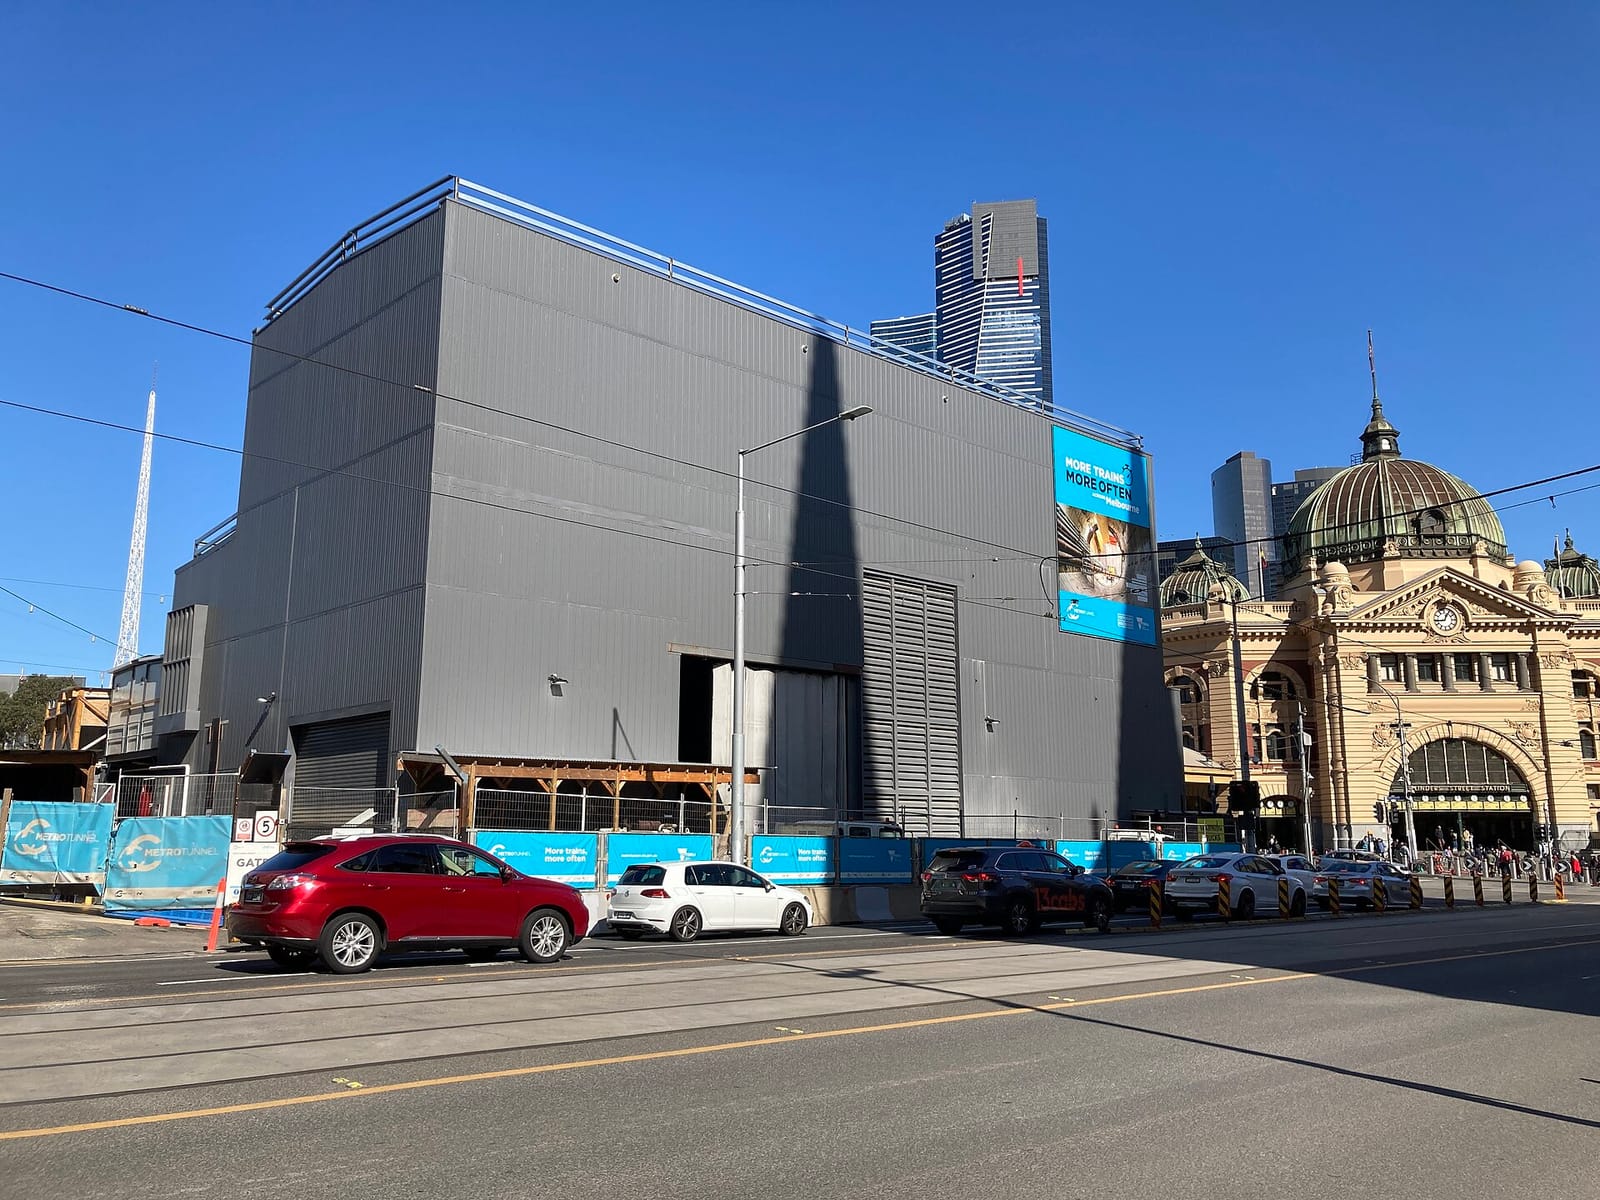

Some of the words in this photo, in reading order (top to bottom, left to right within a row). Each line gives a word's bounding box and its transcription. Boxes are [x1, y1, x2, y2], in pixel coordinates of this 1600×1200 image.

[1065, 457, 1092, 474] MORE
[1093, 465, 1125, 485] TRAINS
[1066, 470, 1097, 491] MORE
[1098, 481, 1132, 500] OFTEN
[1105, 496, 1140, 514] Melbourne
[262, 820, 270, 833] 5
[544, 847, 564, 855] More
[1034, 887, 1086, 911] 13cabs
